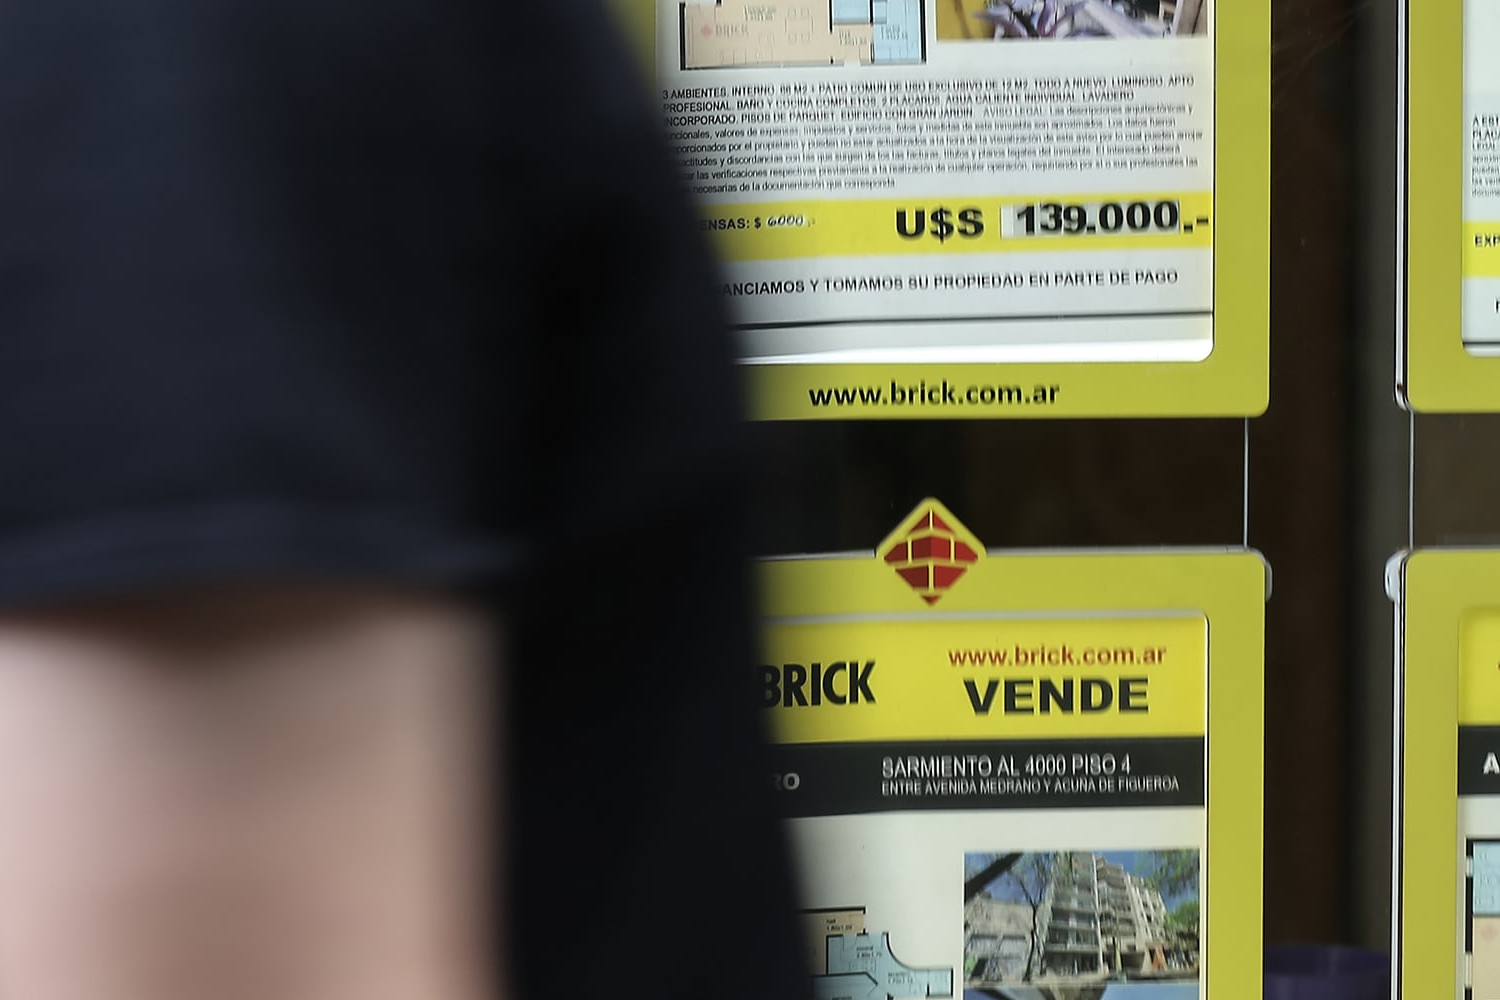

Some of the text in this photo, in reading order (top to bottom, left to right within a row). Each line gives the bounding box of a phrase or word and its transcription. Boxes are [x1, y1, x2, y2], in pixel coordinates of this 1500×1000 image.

[666, 116, 739, 126] NCORPORADO.
[700, 217, 750, 231] ENSAS:
[754, 216, 762, 230] $
[895, 200, 1209, 242] U$S 139.000.-
[722, 270, 1180, 296] ANCIAMOS Y TOMAMOS SU PROPIEDAD EN PARTE DE PAGO
[809, 380, 1061, 407] www.brick.com.ar
[948, 644, 1167, 667] www.brick.com.ar
[758, 661, 876, 708] BRICK
[964, 677, 1150, 715] VENDE
[882, 754, 1132, 778] SARMIENTO AL 4000 PISO 4
[882, 780, 921, 796] ENTRE
[926, 779, 976, 795] AVENIDA
[980, 778, 1040, 794] MEDRANO
[1043, 778, 1051, 794] Y
[1099, 777, 1114, 793] DE
[1119, 776, 1180, 792] FIGUEROA
